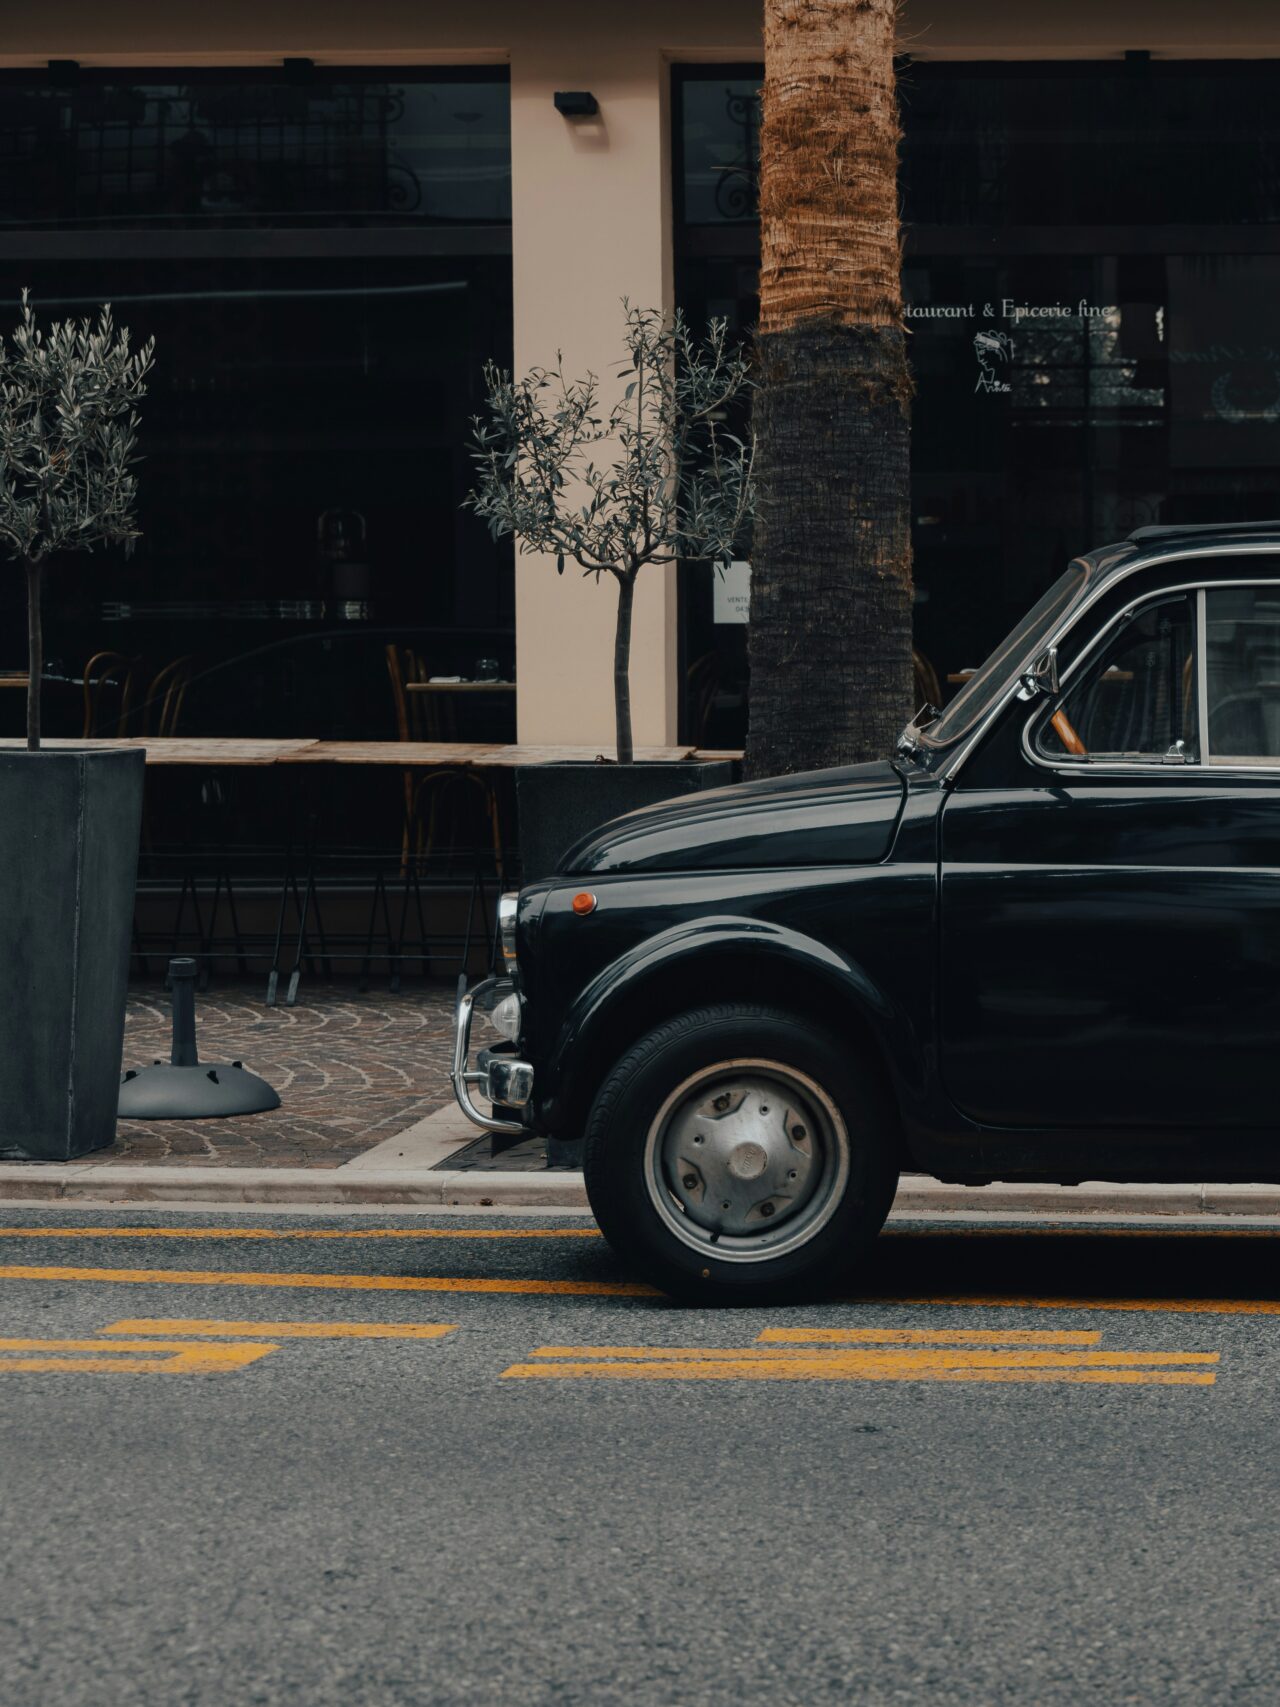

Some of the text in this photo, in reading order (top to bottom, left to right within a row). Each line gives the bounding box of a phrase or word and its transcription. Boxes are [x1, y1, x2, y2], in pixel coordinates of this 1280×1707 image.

[982, 303, 995, 318] &
[1002, 298, 1072, 324] Epicerie
[1078, 299, 1112, 318] fine
